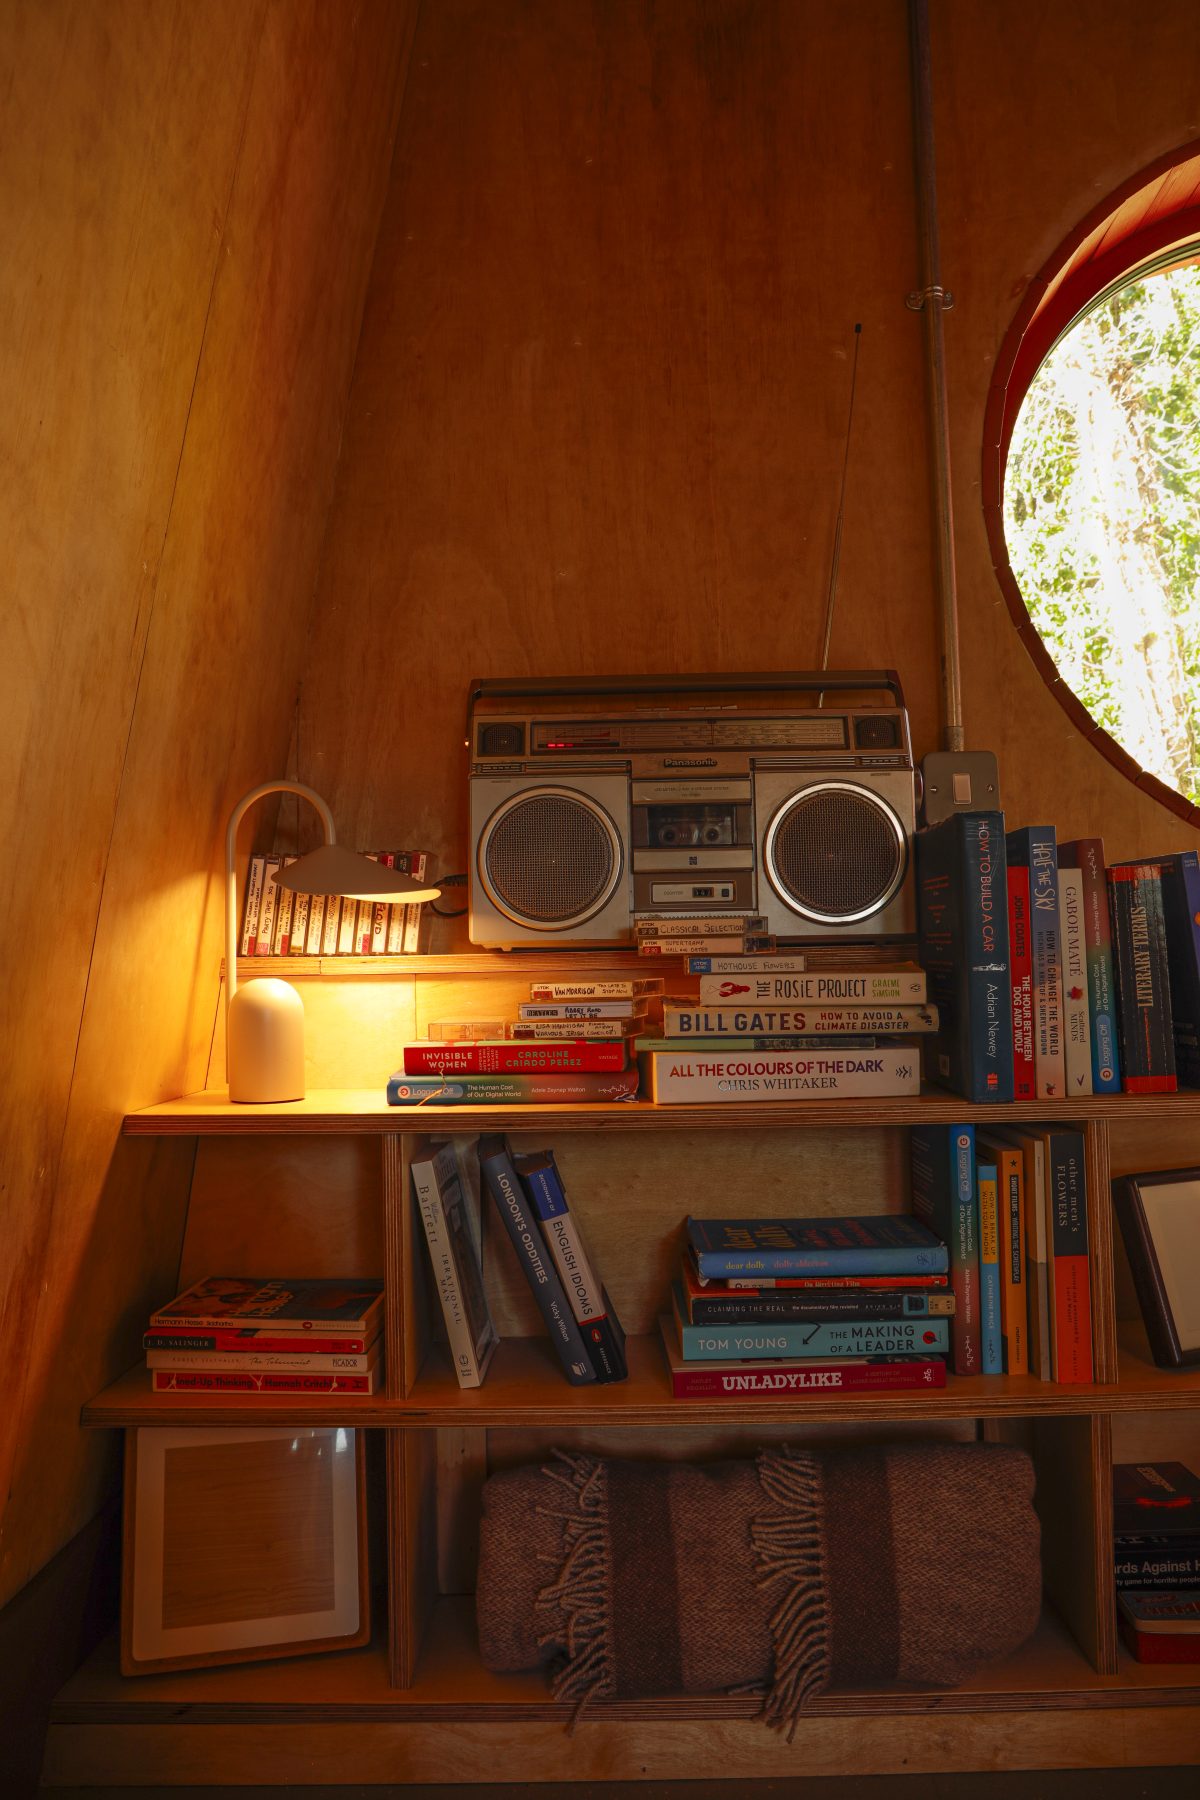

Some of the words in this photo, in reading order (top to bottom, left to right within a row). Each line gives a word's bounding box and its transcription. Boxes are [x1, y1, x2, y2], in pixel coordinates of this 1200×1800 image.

[664, 758, 718, 768] Panasonic
[978, 820, 990, 851] HOW
[980, 855, 991, 873] TO
[1031, 842, 1055, 868] HALF
[1037, 869, 1051, 886] THE
[980, 876, 992, 911] BUILD
[1034, 887, 1056, 911] SKY
[1014, 895, 1023, 919] JOHN
[1066, 887, 1078, 934] GABOR
[262, 917, 271, 934] PARTY
[704, 923, 744, 933] SELECTION
[982, 914, 992, 924] A
[1130, 906, 1149, 948] TERMS
[982, 925, 994, 953] CAR
[1015, 922, 1025, 957] COATES
[1036, 931, 1044, 961] NICHOLAS
[1046, 930, 1056, 950] HOW
[718, 961, 758, 970] HOTHOUSE
[763, 961, 795, 969] FLOWERS
[1047, 953, 1056, 964] TO
[1068, 938, 1083, 976] MATÉ
[756, 980, 771, 998] THE
[818, 978, 867, 998] PROJECT
[872, 979, 900, 988] GRAEME
[1022, 976, 1031, 992] THE
[1038, 971, 1046, 997] KRISTOF
[1048, 967, 1057, 1002] CHANGE
[1094, 978, 1102, 999] Human
[1101, 973, 1109, 992] Digital
[1133, 950, 1154, 1008] LITERARY
[987, 983, 999, 1018] Adrian
[1013, 987, 1022, 1005] DOG
[1022, 994, 1031, 1018] HOUR
[679, 1013, 728, 1032] BILL
[735, 1012, 806, 1031] GATES
[820, 1012, 843, 1021] HOW
[846, 1012, 859, 1020] TO
[862, 1012, 894, 1020] AVOID
[896, 1011, 904, 1019] A
[1013, 1008, 1022, 1027] AND
[1049, 1005, 1058, 1021] THE
[815, 1021, 857, 1031] CLIMATE
[860, 1020, 910, 1030] DISASTER
[1070, 1013, 1079, 1042] MINDS
[1077, 1011, 1087, 1043] Scattered
[1099, 1024, 1108, 1036] Off
[986, 1021, 1000, 1058] Newey
[1014, 1029, 1023, 1054] WOLF
[1023, 1020, 1032, 1061] BETWEEN
[1049, 1025, 1059, 1056] WORLD
[422, 1052, 473, 1060] INVISIBLE
[518, 1050, 568, 1059] CAROLINE
[1100, 1037, 1111, 1066] Logging
[428, 1060, 467, 1069] WOMEN
[506, 1058, 546, 1067] CRIADO
[550, 1058, 582, 1067] PEREZ
[670, 1064, 694, 1078] ALL
[696, 1063, 724, 1077] THE
[726, 1061, 795, 1076] COLOURS
[797, 1061, 815, 1075] OF
[818, 1060, 844, 1074] THE
[846, 1058, 884, 1073] DARK
[485, 1090, 506, 1099] Digital
[718, 1079, 760, 1092] CHRIS
[763, 1077, 839, 1090] WHITAKER
[960, 1150, 968, 1179] Logging
[1069, 1158, 1079, 1192] other
[538, 1173, 553, 1204] DICTIONARY
[1057, 1165, 1068, 1227] FLOWERS
[418, 1184, 438, 1243] Barrett
[989, 1211, 995, 1220] TO
[1071, 1196, 1081, 1233] men's
[496, 1173, 528, 1230] LONDON'S
[522, 1234, 549, 1284] ODDITIES
[991, 1246, 996, 1256] UP
[553, 1221, 578, 1271] ENGLISH
[570, 1273, 593, 1316] IDIOMS
[725, 1260, 744, 1270] dear
[746, 1259, 766, 1271] dolly
[774, 1258, 794, 1269] dolly
[439, 1278, 451, 1303] MAN
[441, 1253, 462, 1325] IRRATIONAL
[549, 1301, 564, 1319] Vicky
[556, 1319, 571, 1342] Wilson
[829, 1331, 848, 1339] THE
[851, 1325, 915, 1339] MAKING
[169, 1338, 209, 1347] SALINGER
[697, 1338, 729, 1351] TOM
[735, 1337, 788, 1349] YOUNG
[830, 1345, 843, 1353] OF
[856, 1339, 916, 1352] LEADER
[333, 1358, 358, 1367] PICADOR
[215, 1375, 253, 1388] Thinking
[264, 1376, 301, 1387] Hannah
[722, 1371, 844, 1391] UNLADYLIKE
[1114, 1561, 1138, 1574] rds
[1142, 1560, 1192, 1575] Against
[1153, 1576, 1178, 1584] horrible
